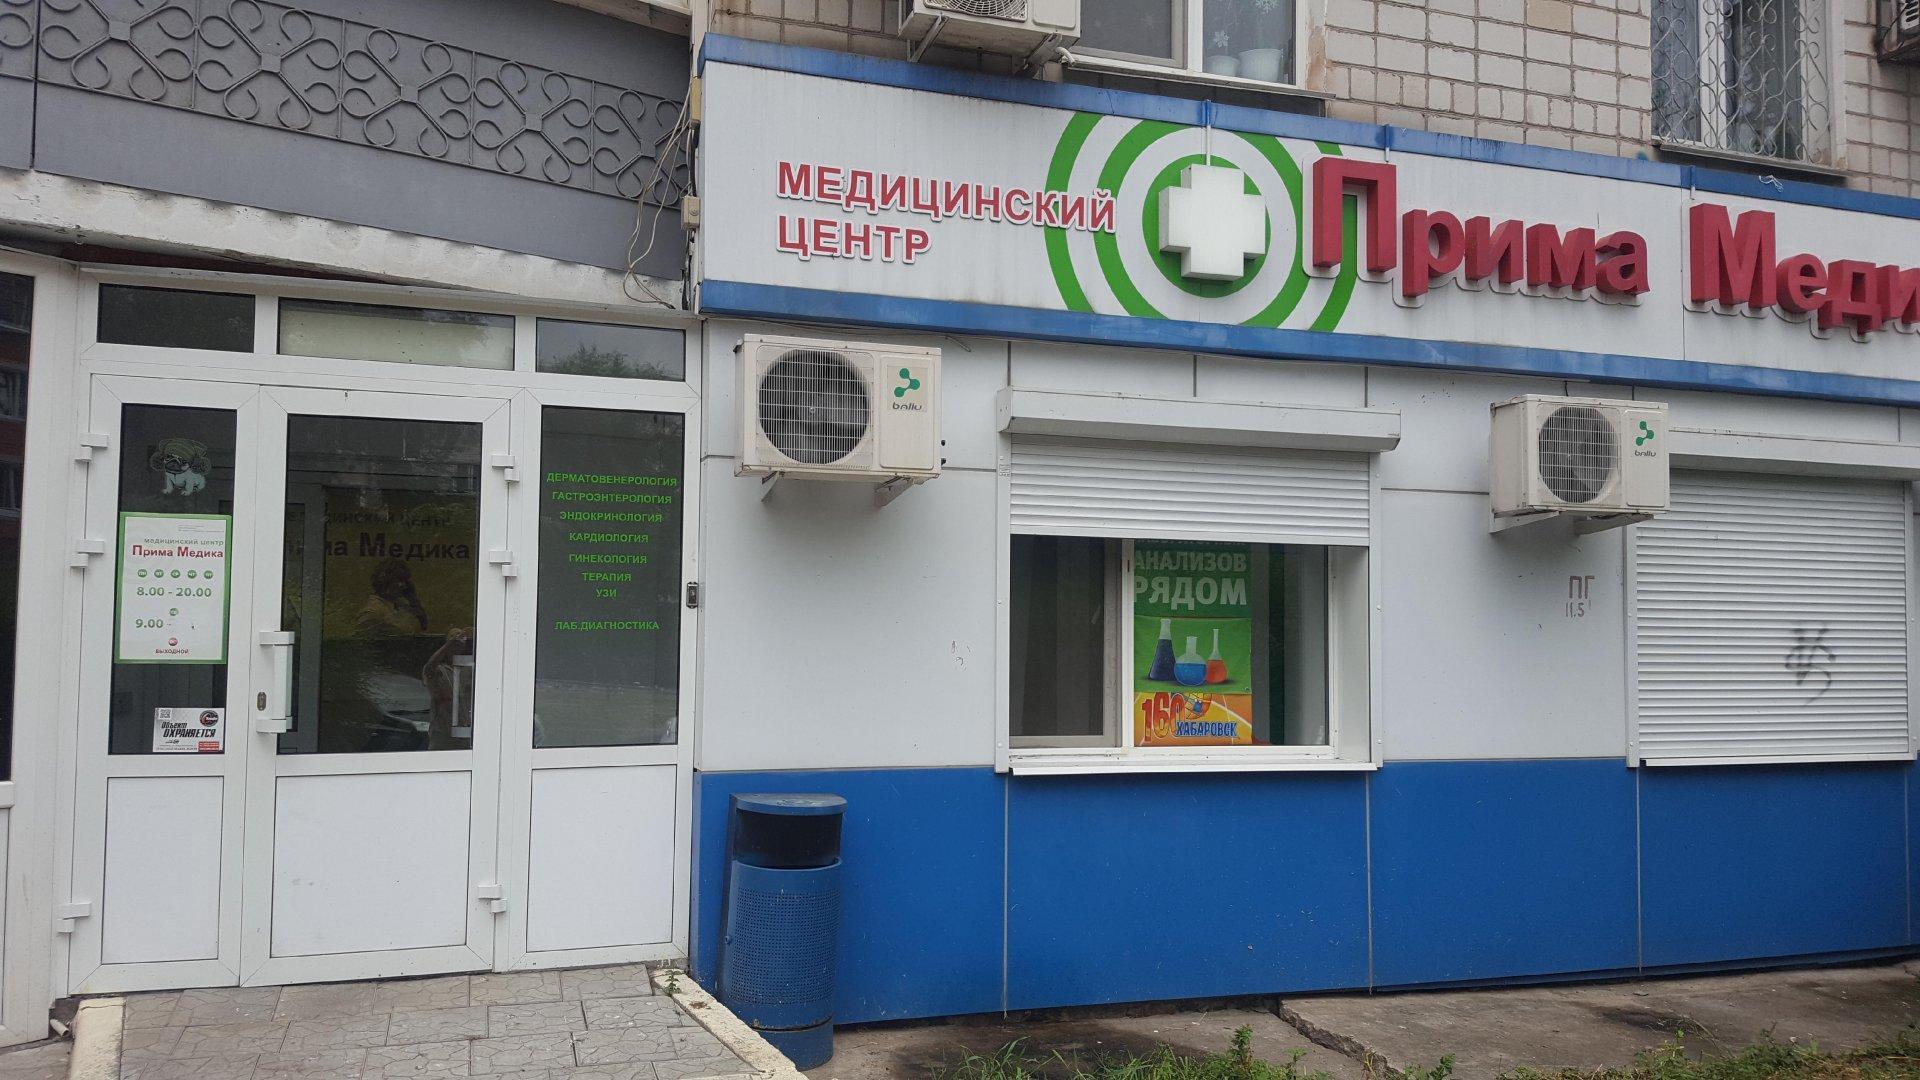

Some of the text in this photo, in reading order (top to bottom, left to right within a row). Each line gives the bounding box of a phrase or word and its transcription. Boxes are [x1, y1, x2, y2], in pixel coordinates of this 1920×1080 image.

[778, 160, 1116, 231] МЕДИЦИНСКИЙ
[1312, 156, 1650, 298] Прима
[778, 215, 930, 262] ЦЕНТР
[546, 472, 678, 487] ДЕРМАТОВЕНЕРОЛОГИЯ
[552, 491, 672, 505] ГАСТРОЭНТЕРОЛОГИЯ
[559, 511, 663, 524] ЭНДОКРИНОЛОГИЯ
[569, 530, 649, 544] КАРДИОЛОГИЯ
[132, 544, 224, 559] Прима Медика
[568, 553, 648, 566] ГИНЕКОЛОГИЯ
[1134, 551, 1247, 573] АНАЛИЗОВ
[581, 571, 632, 583] ТЕРАПИЯ
[136, 586, 165, 596] 8.00
[175, 587, 212, 598] 20.00
[595, 587, 618, 599] УЗИ
[1134, 577, 1247, 611] РЯДОМ
[1569, 575, 1595, 599] ПГ
[135, 618, 164, 629] 9.00
[1142, 692, 1187, 741] 160
[163, 728, 217, 738] ОХРАНЯЕТСЯ
[1175, 720, 1239, 738] ХАБАРОВСК
